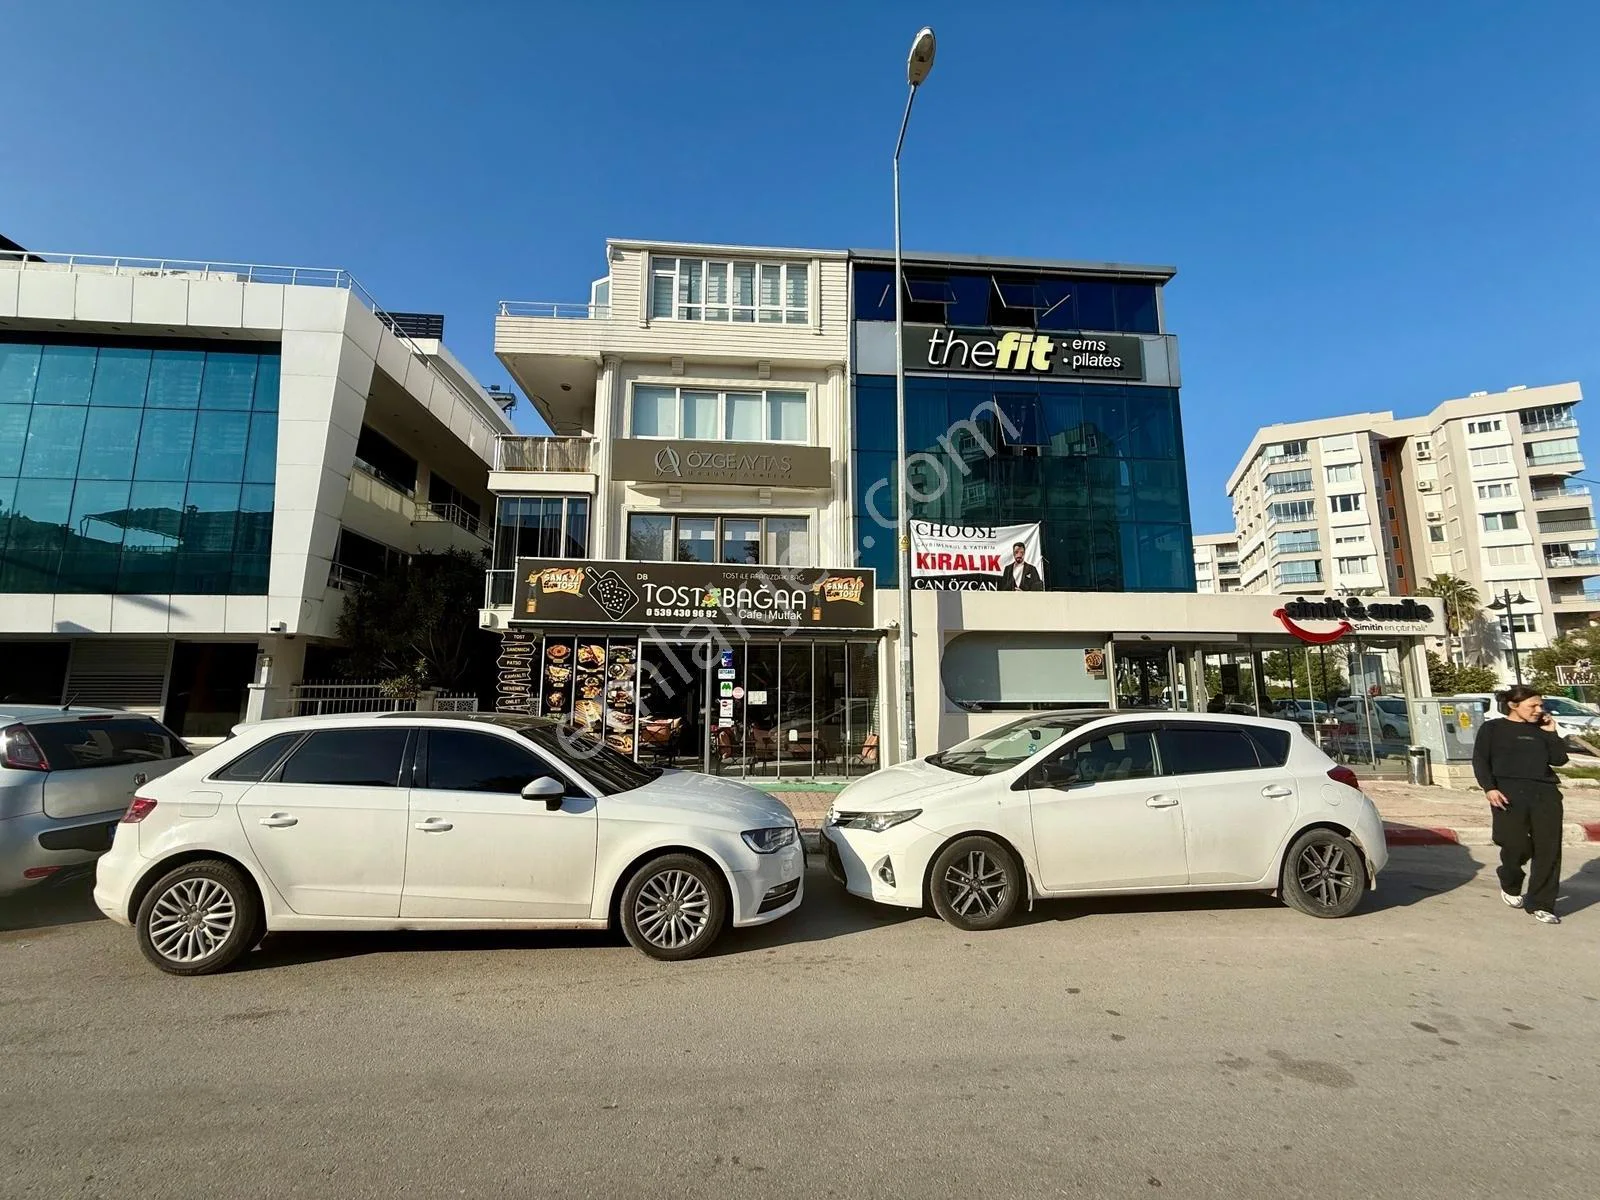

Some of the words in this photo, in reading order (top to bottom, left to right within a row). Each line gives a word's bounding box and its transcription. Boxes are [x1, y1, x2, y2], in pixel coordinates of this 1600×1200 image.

[1072, 339, 1106, 352] ems
[1072, 353, 1121, 370] pilates
[915, 522, 997, 539] CHOOSE
[636, 573, 649, 581] DB
[722, 572, 738, 580] TOST
[557, 581, 580, 590] TOST
[914, 578, 945, 591] CAN
[948, 578, 998, 592] ÖZCAN
[646, 608, 653, 617] 0
[653, 608, 672, 617] 539
[673, 609, 691, 618] 430
[705, 610, 718, 618] 92
[738, 610, 763, 619] Cafe
[768, 611, 803, 621] Mutfak
